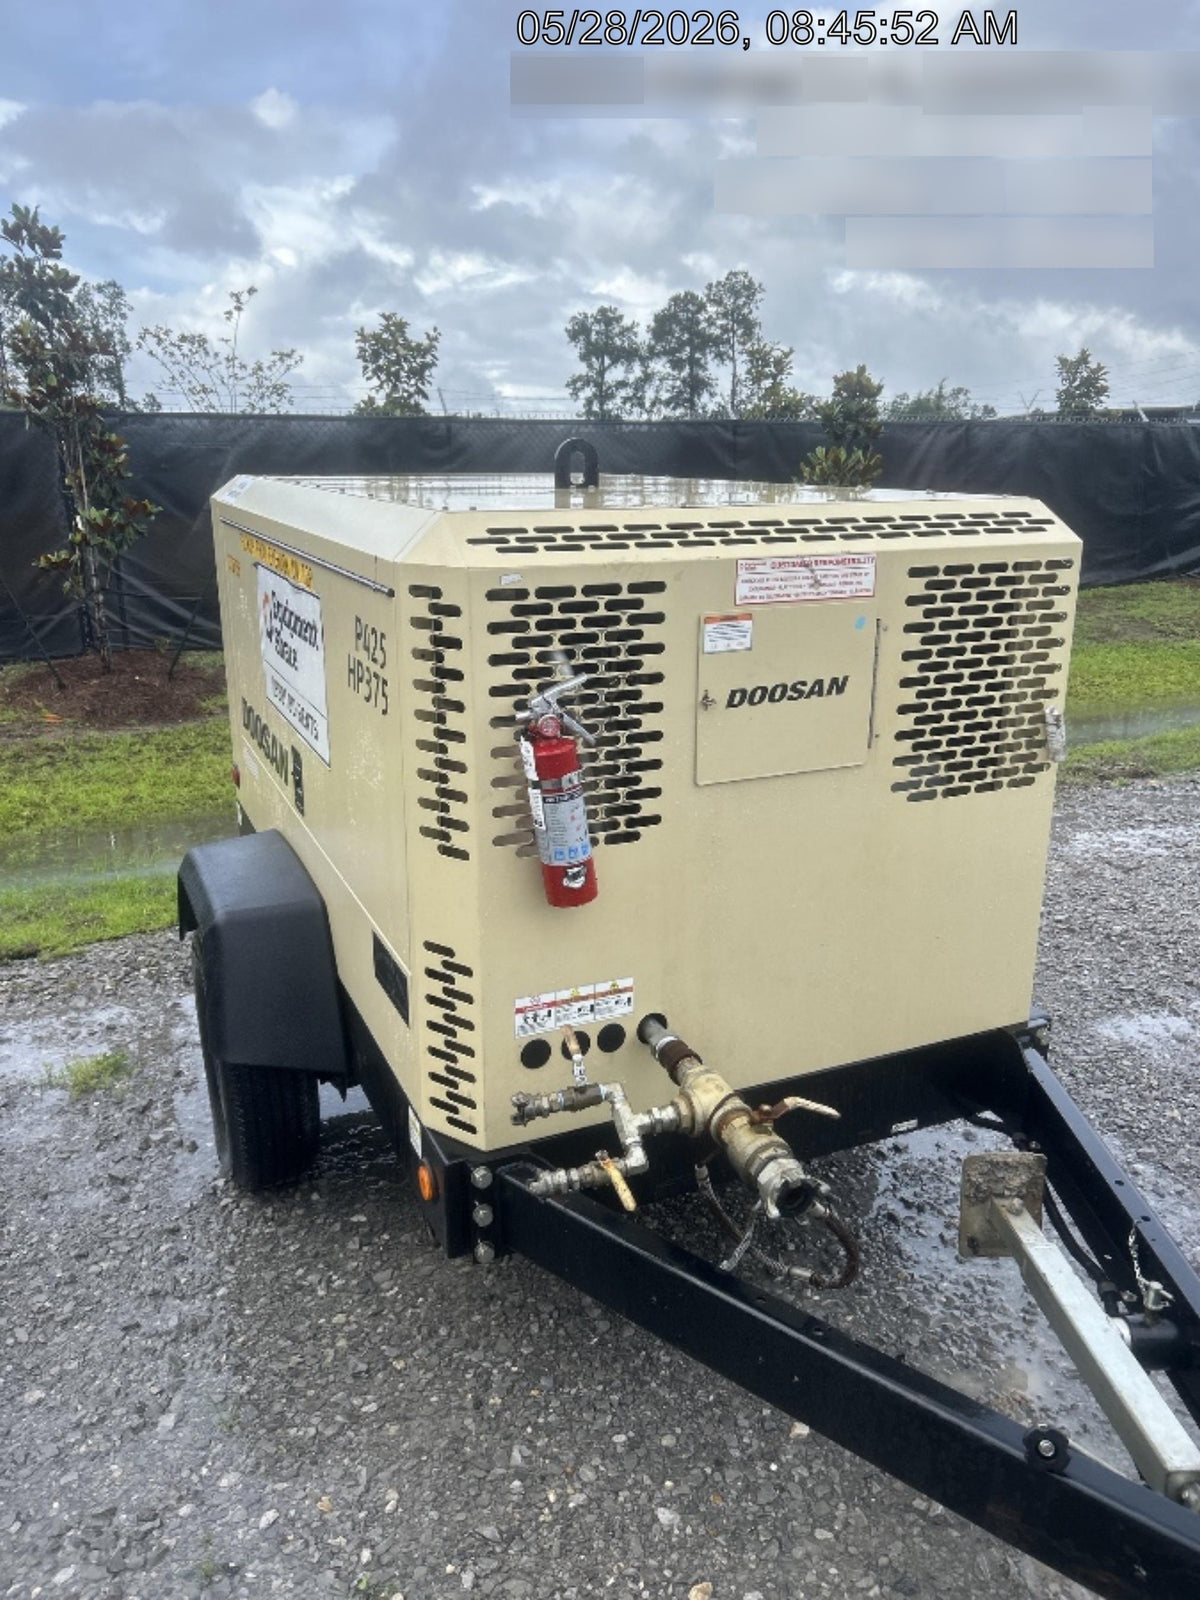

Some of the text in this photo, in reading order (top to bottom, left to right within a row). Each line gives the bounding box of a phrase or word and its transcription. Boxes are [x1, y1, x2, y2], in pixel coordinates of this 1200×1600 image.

[354, 614, 386, 669] P425
[347, 653, 388, 716] HP375
[726, 675, 850, 709] DOOSAN
[241, 697, 289, 786] DOOSAN
